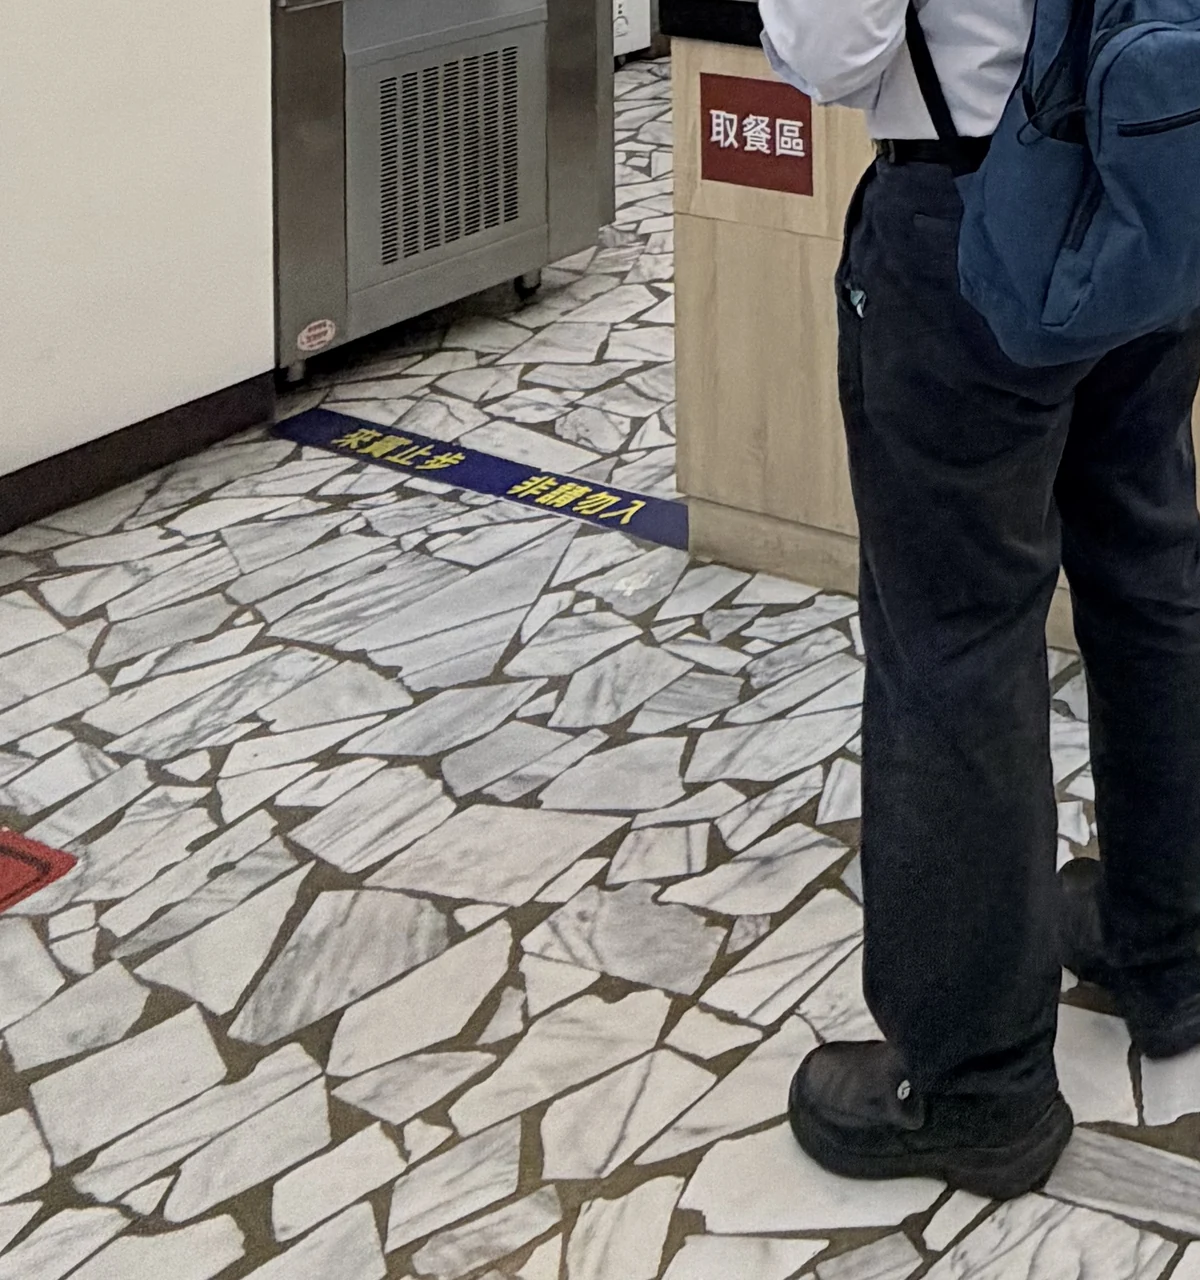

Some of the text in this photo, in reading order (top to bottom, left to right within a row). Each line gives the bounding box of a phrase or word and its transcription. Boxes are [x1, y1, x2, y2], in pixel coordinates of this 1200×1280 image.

[709, 109, 805, 158] 取餐區
[331, 428, 647, 525] 來賓止步 非請勿入
